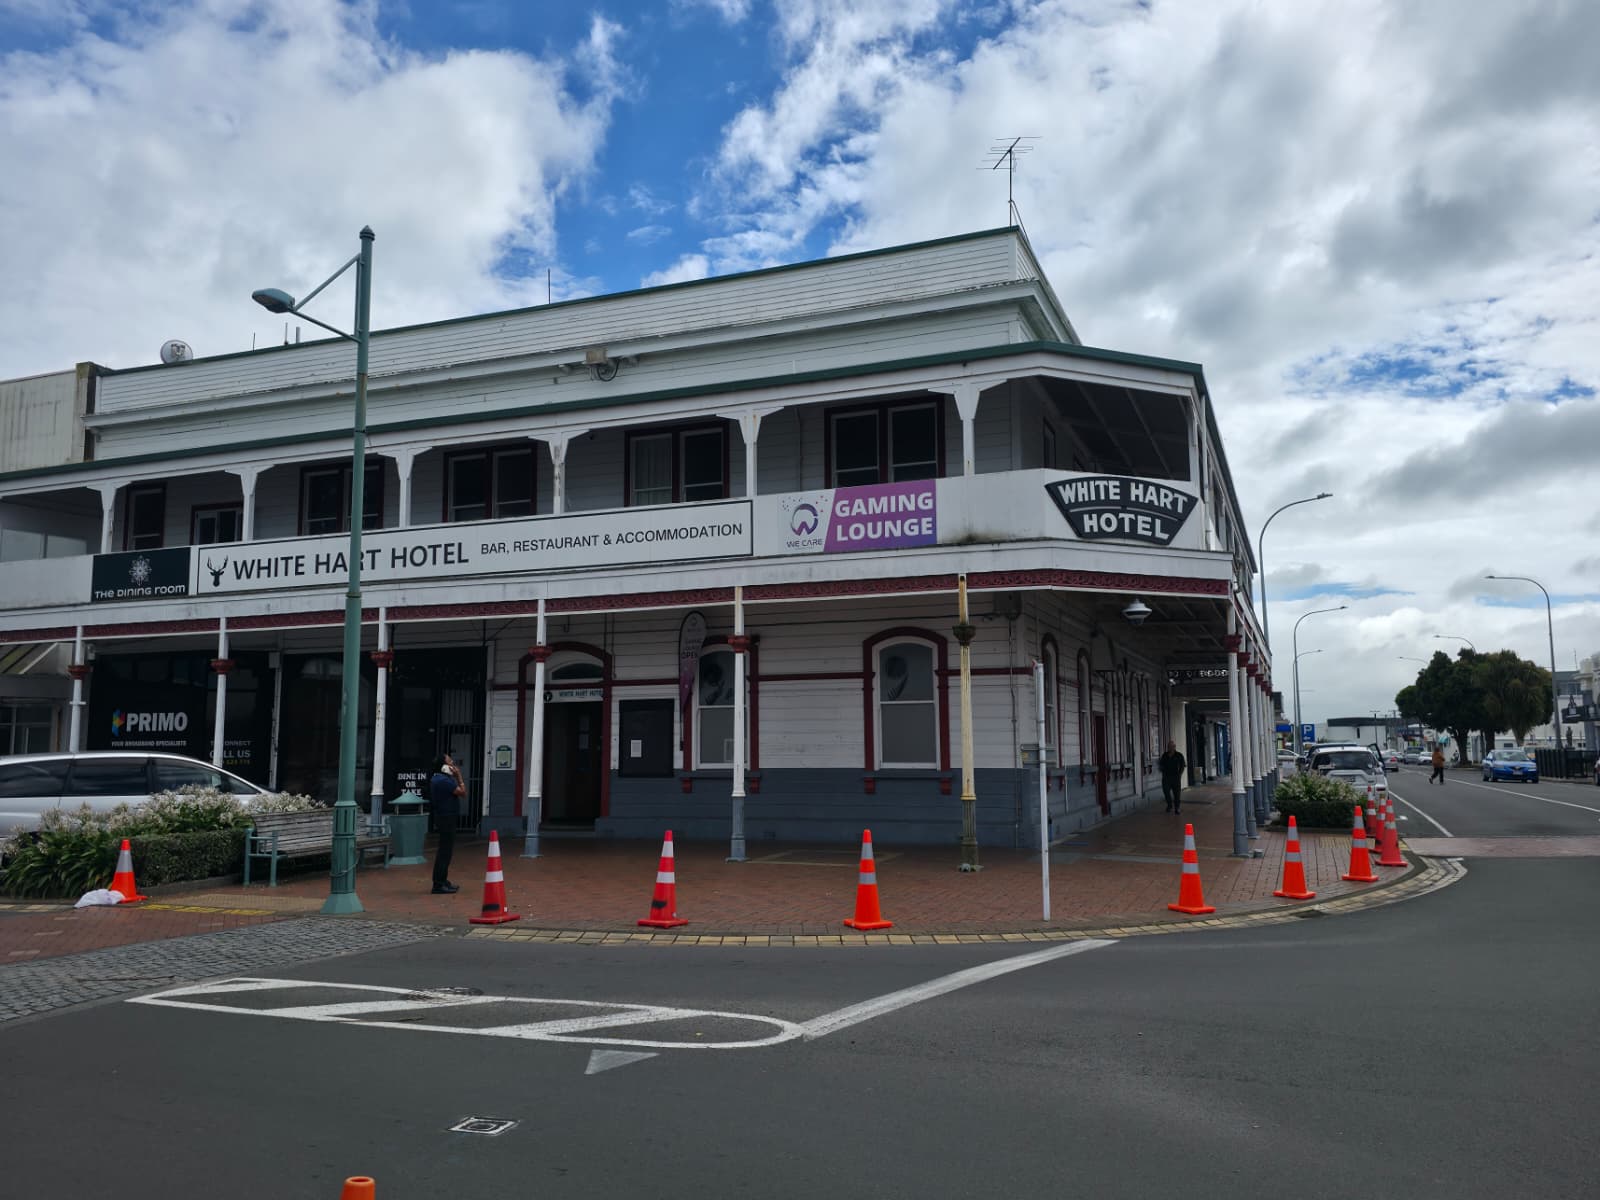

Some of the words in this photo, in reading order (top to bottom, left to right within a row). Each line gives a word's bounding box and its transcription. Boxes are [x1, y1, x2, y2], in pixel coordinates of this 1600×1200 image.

[835, 492, 933, 517] GAMING
[1057, 480, 1121, 505] WHITE
[1130, 482, 1188, 514] HART
[836, 517, 933, 542] LOUNGE
[1083, 512, 1170, 540] HOTEL
[481, 542, 509, 555] BAR,
[513, 535, 599, 553] RESTAURANT
[603, 534, 612, 545] &
[616, 523, 742, 544] ACCOMMODATION
[786, 540, 800, 548] WE
[801, 539, 823, 547] CARE
[233, 555, 305, 580] WHITE
[391, 542, 469, 568] HOTEL
[126, 712, 188, 732] PRIMO
[1303, 725, 1313, 735] P
[237, 750, 250, 758] US
